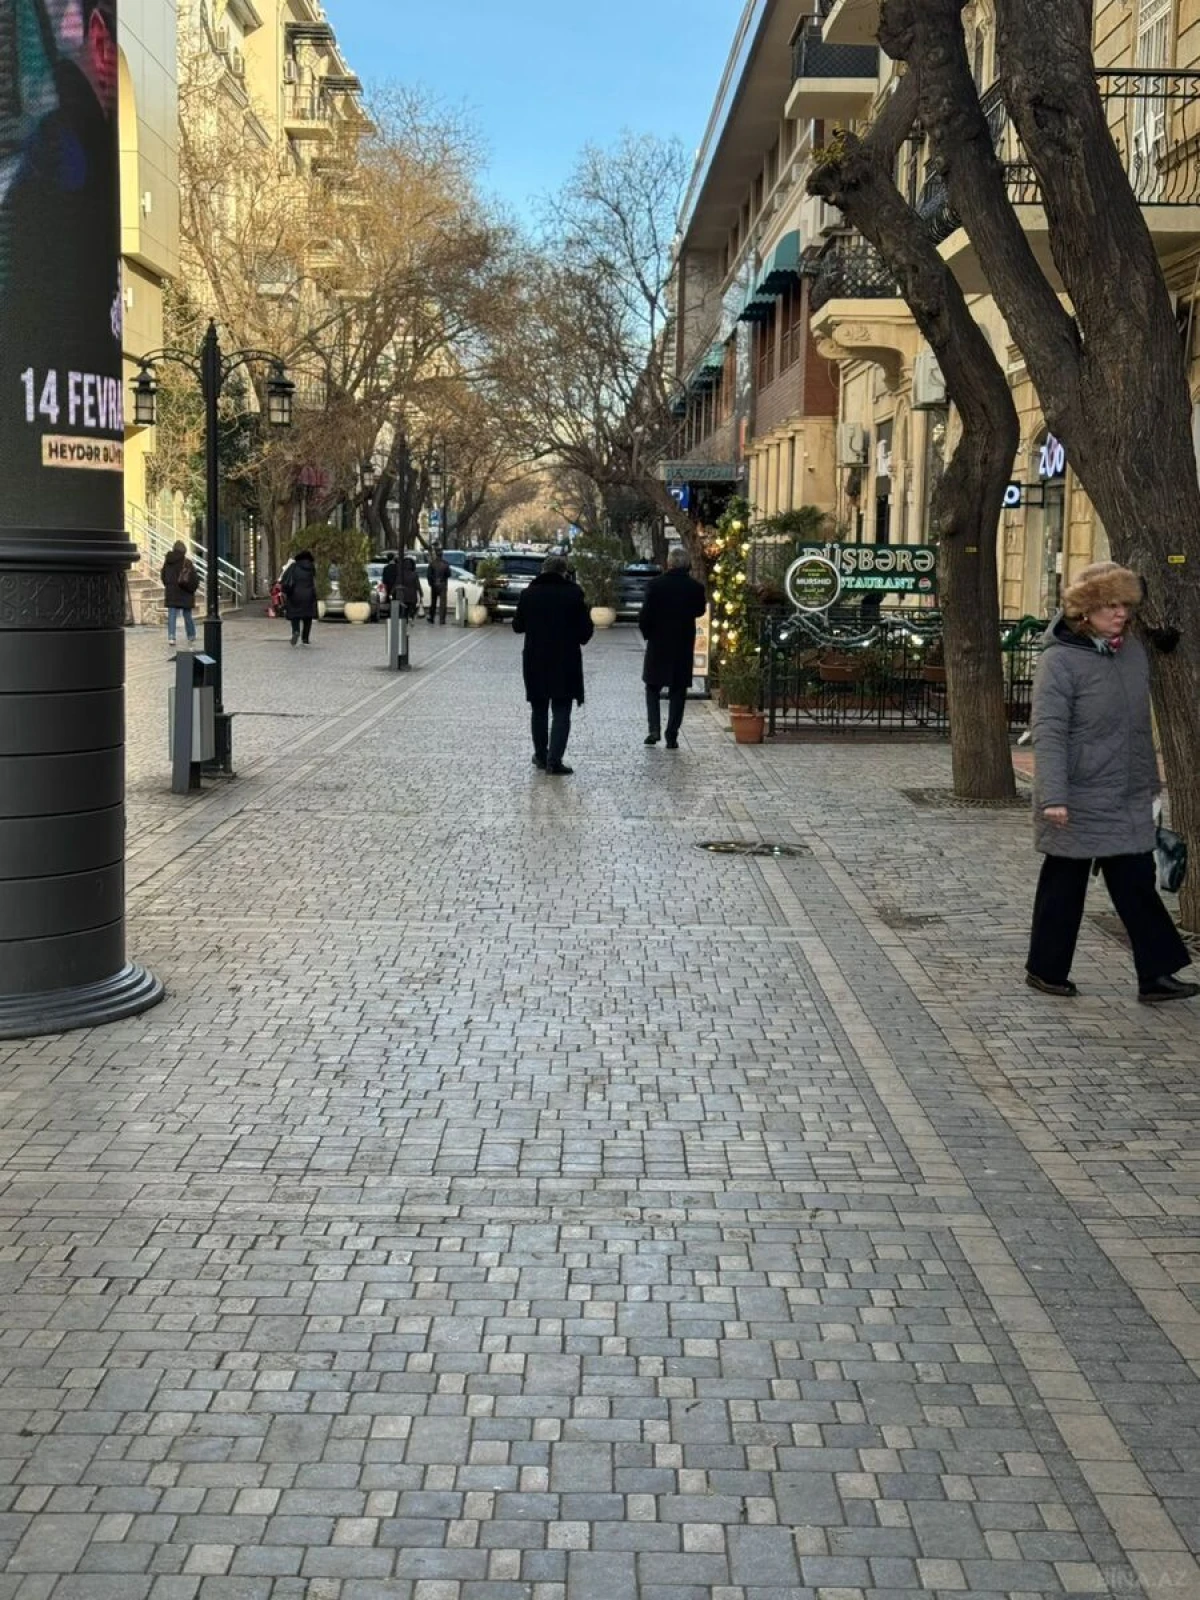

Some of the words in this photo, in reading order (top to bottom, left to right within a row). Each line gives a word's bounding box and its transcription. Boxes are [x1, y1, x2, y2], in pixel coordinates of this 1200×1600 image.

[21, 367, 60, 424] 14
[48, 442, 101, 461] HEYDƏR
[796, 577, 832, 585] MURSHID
[840, 576, 916, 589] STAURANT
